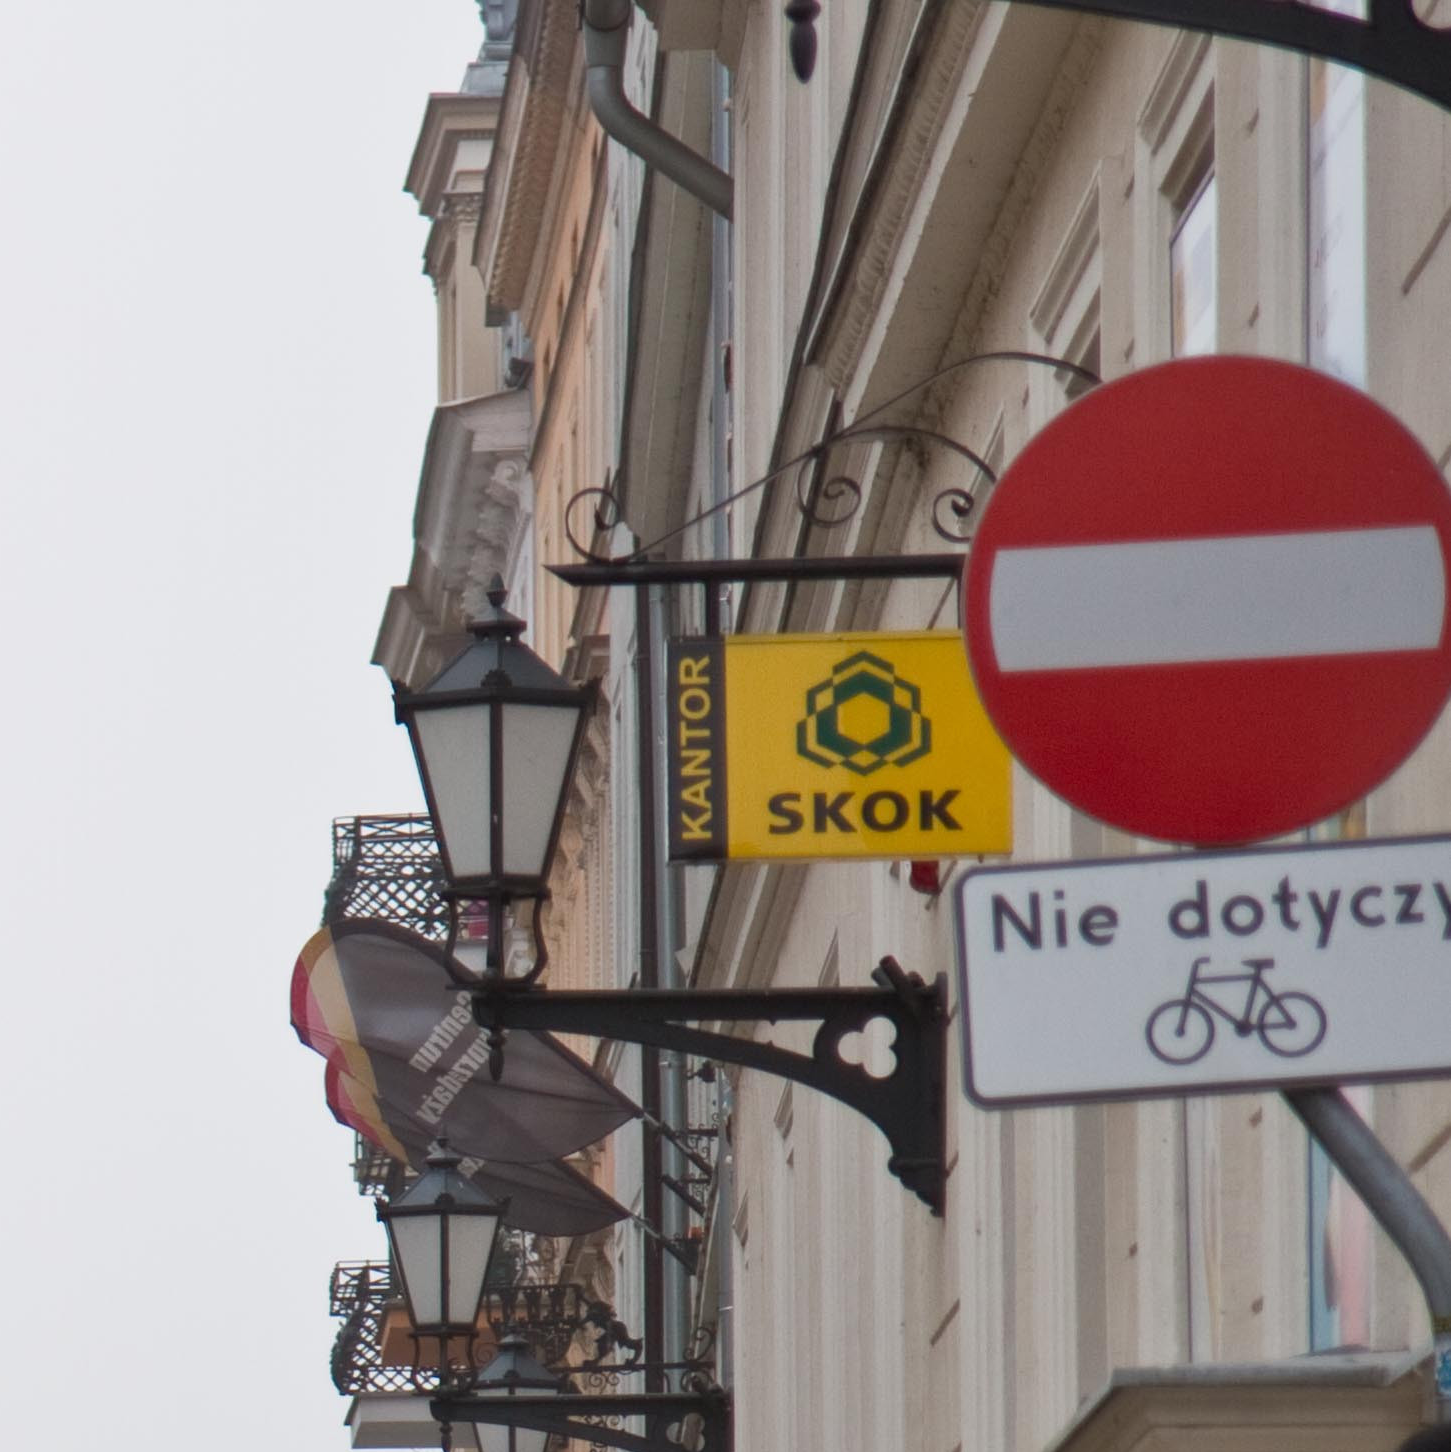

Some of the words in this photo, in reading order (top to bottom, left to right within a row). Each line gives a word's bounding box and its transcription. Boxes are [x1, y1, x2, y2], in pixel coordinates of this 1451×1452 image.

[679, 655, 713, 841] KANTOR
[767, 789, 964, 835] SKOK
[990, 889, 1119, 953] Nie
